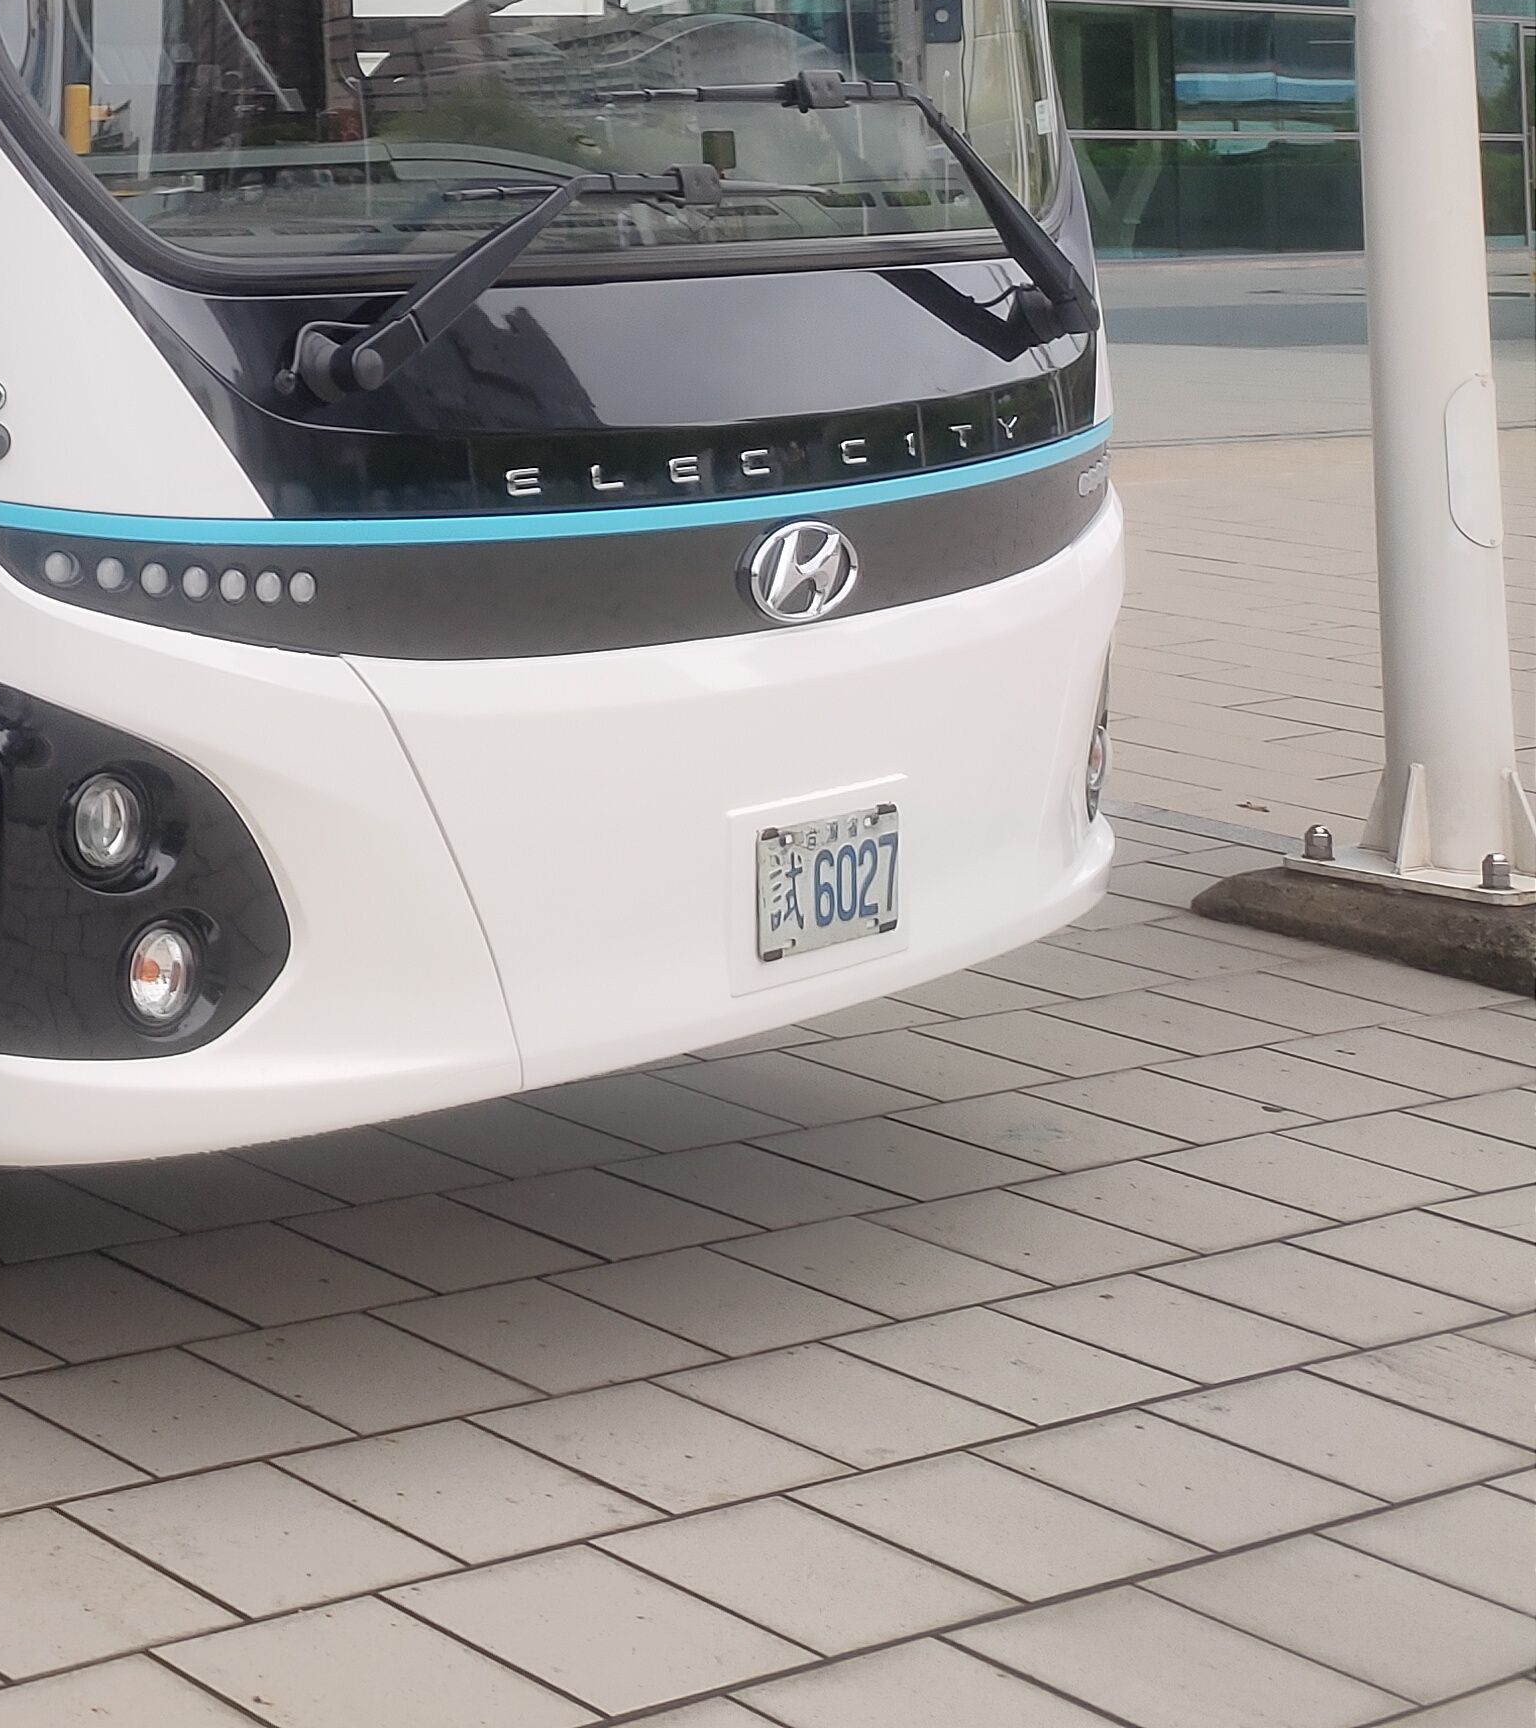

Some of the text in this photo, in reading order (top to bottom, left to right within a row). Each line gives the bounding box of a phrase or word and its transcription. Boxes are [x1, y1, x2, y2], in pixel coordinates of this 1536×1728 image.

[505, 414, 1019, 497] ELEC CITY
[813, 831, 899, 929] 6027
